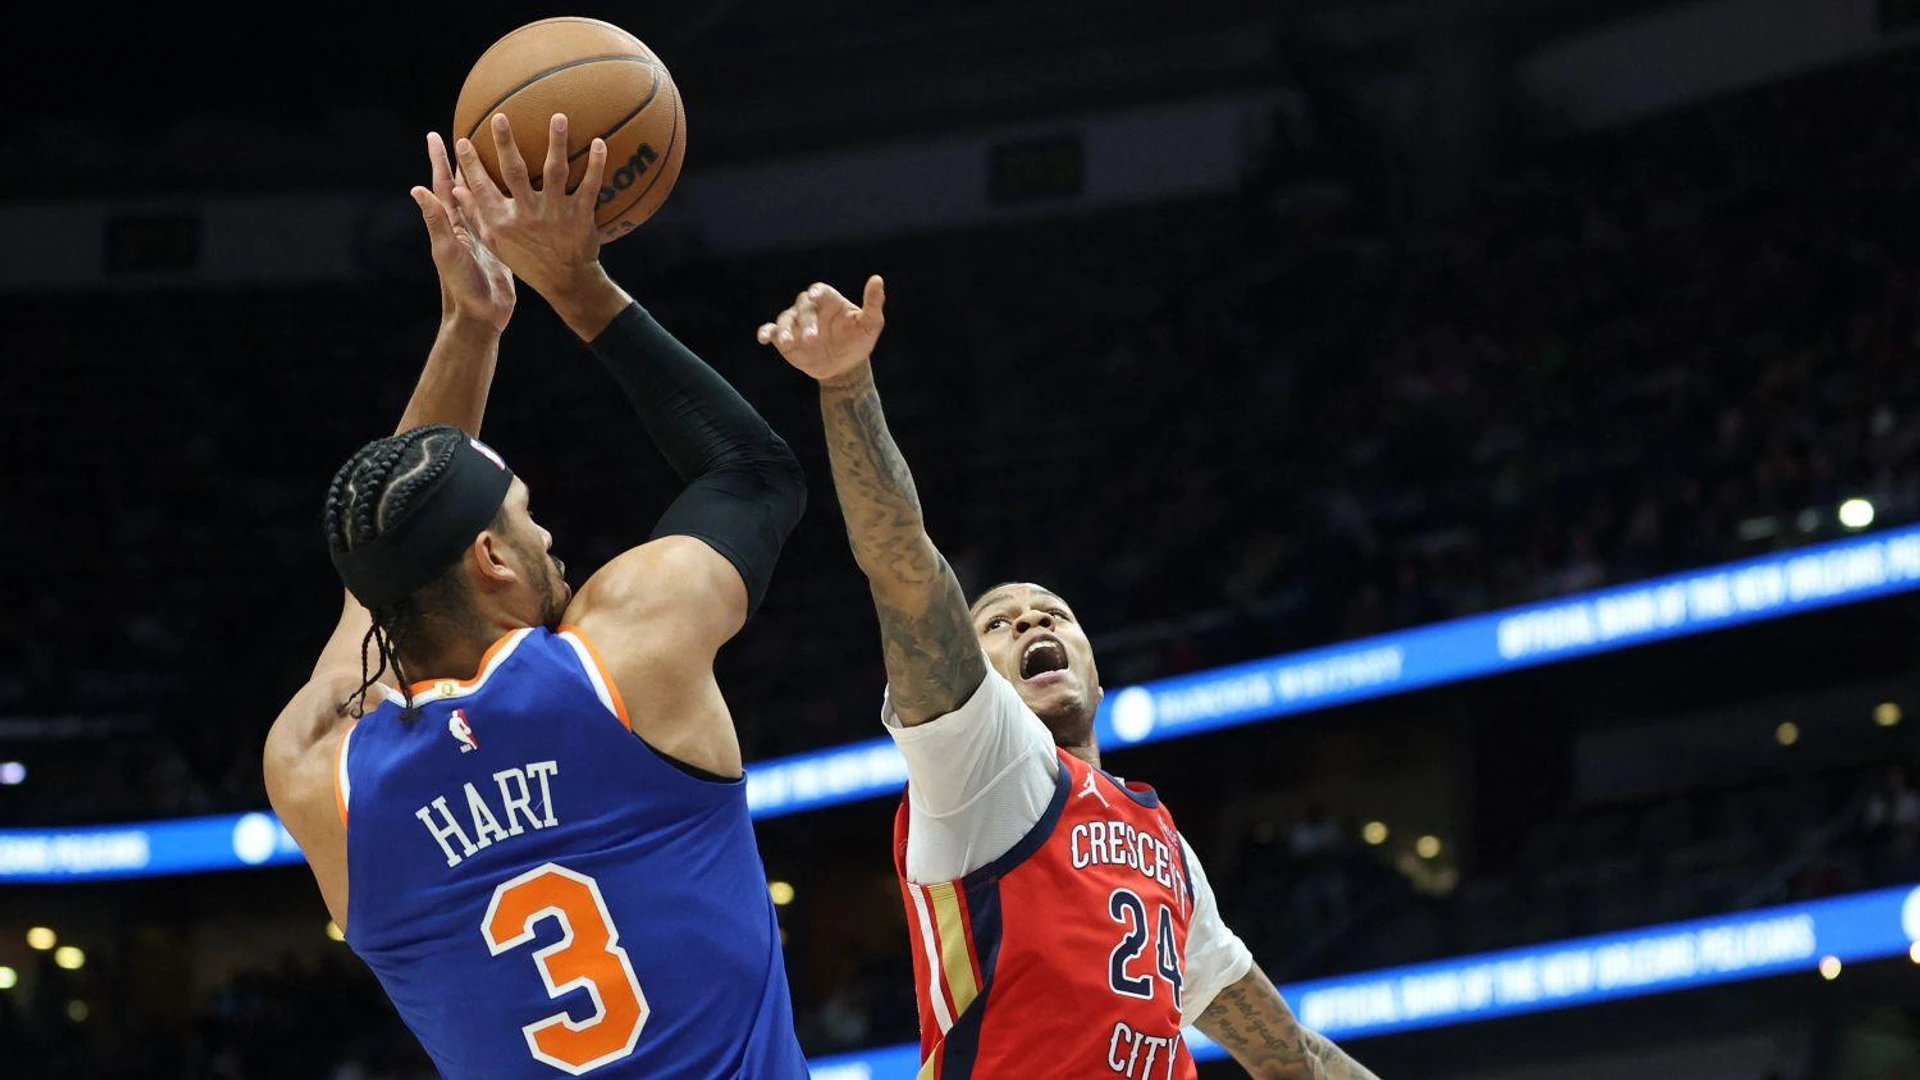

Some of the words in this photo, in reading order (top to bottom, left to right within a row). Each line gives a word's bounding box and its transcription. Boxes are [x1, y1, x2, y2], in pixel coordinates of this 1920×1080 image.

[597, 142, 658, 209] son
[415, 760, 558, 867] HART
[481, 862, 650, 1076] 3
[1109, 888, 1182, 1013] 24
[1108, 1022, 1180, 1080] CITY
